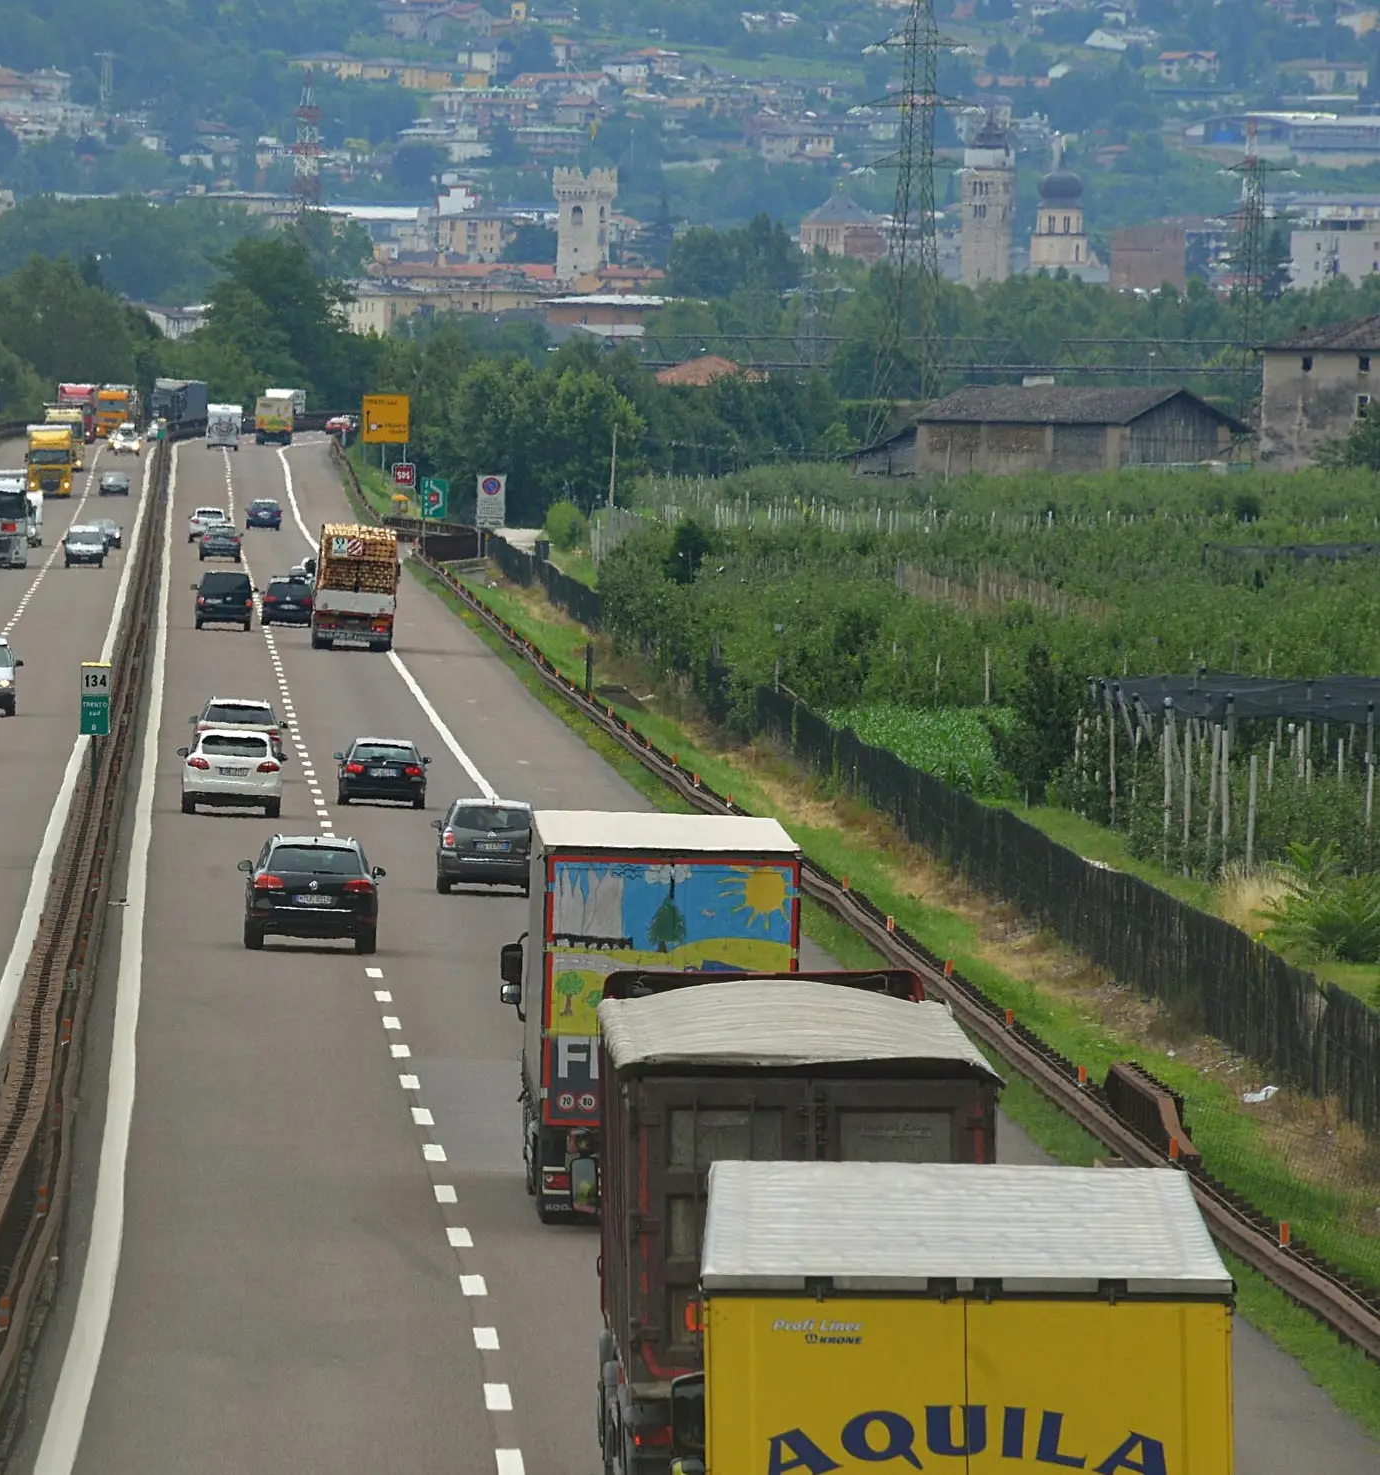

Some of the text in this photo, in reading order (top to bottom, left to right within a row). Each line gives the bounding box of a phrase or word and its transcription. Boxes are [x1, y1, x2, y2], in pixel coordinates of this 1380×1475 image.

[397, 471, 410, 480] SOS
[85, 674, 107, 687] 134
[562, 1097, 572, 1106] 70
[582, 1098, 593, 1106] 80
[772, 1317, 863, 1332] Profi Liner
[819, 1336, 862, 1345] KRONE
[766, 1404, 1169, 1475] AQUILA
